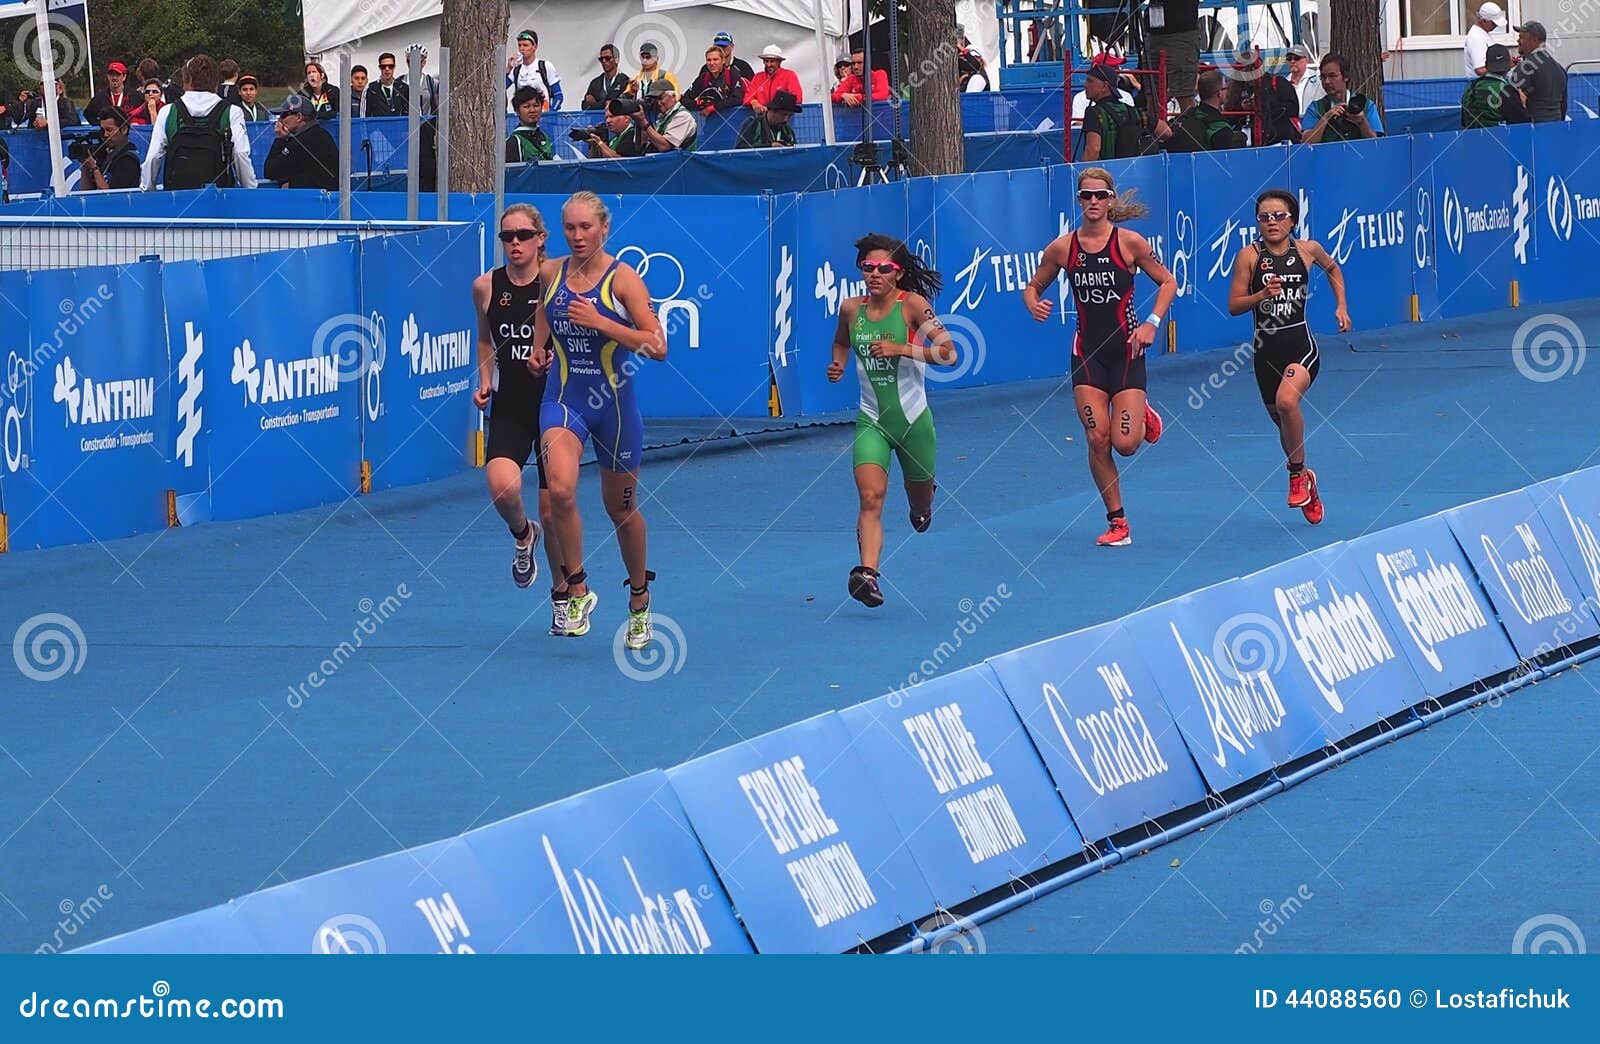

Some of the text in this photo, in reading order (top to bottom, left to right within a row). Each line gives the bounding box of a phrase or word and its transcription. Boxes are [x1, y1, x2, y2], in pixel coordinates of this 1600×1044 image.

[1356, 210, 1405, 249] TELUS
[1464, 200, 1511, 234] TransCanada
[990, 250, 1044, 293] TELU
[1074, 271, 1115, 287] DABNEY
[1077, 288, 1121, 304] USA
[1270, 302, 1292, 317] JPN
[421, 328, 471, 375] ANTRIM
[567, 338, 592, 353] SWE
[865, 357, 895, 371] MEX
[261, 353, 339, 405] ANTRIM
[81, 376, 154, 425] ANTRIM
[260, 403, 339, 431] Construction Transportation
[81, 428, 154, 452] Construction Transportation
[902, 702, 993, 795] EXPLORE
[1042, 661, 1169, 796] Canada
[737, 755, 840, 855] EXPLORE
[945, 783, 1027, 864] EDMONTON
[786, 840, 877, 928] EDMONTON
